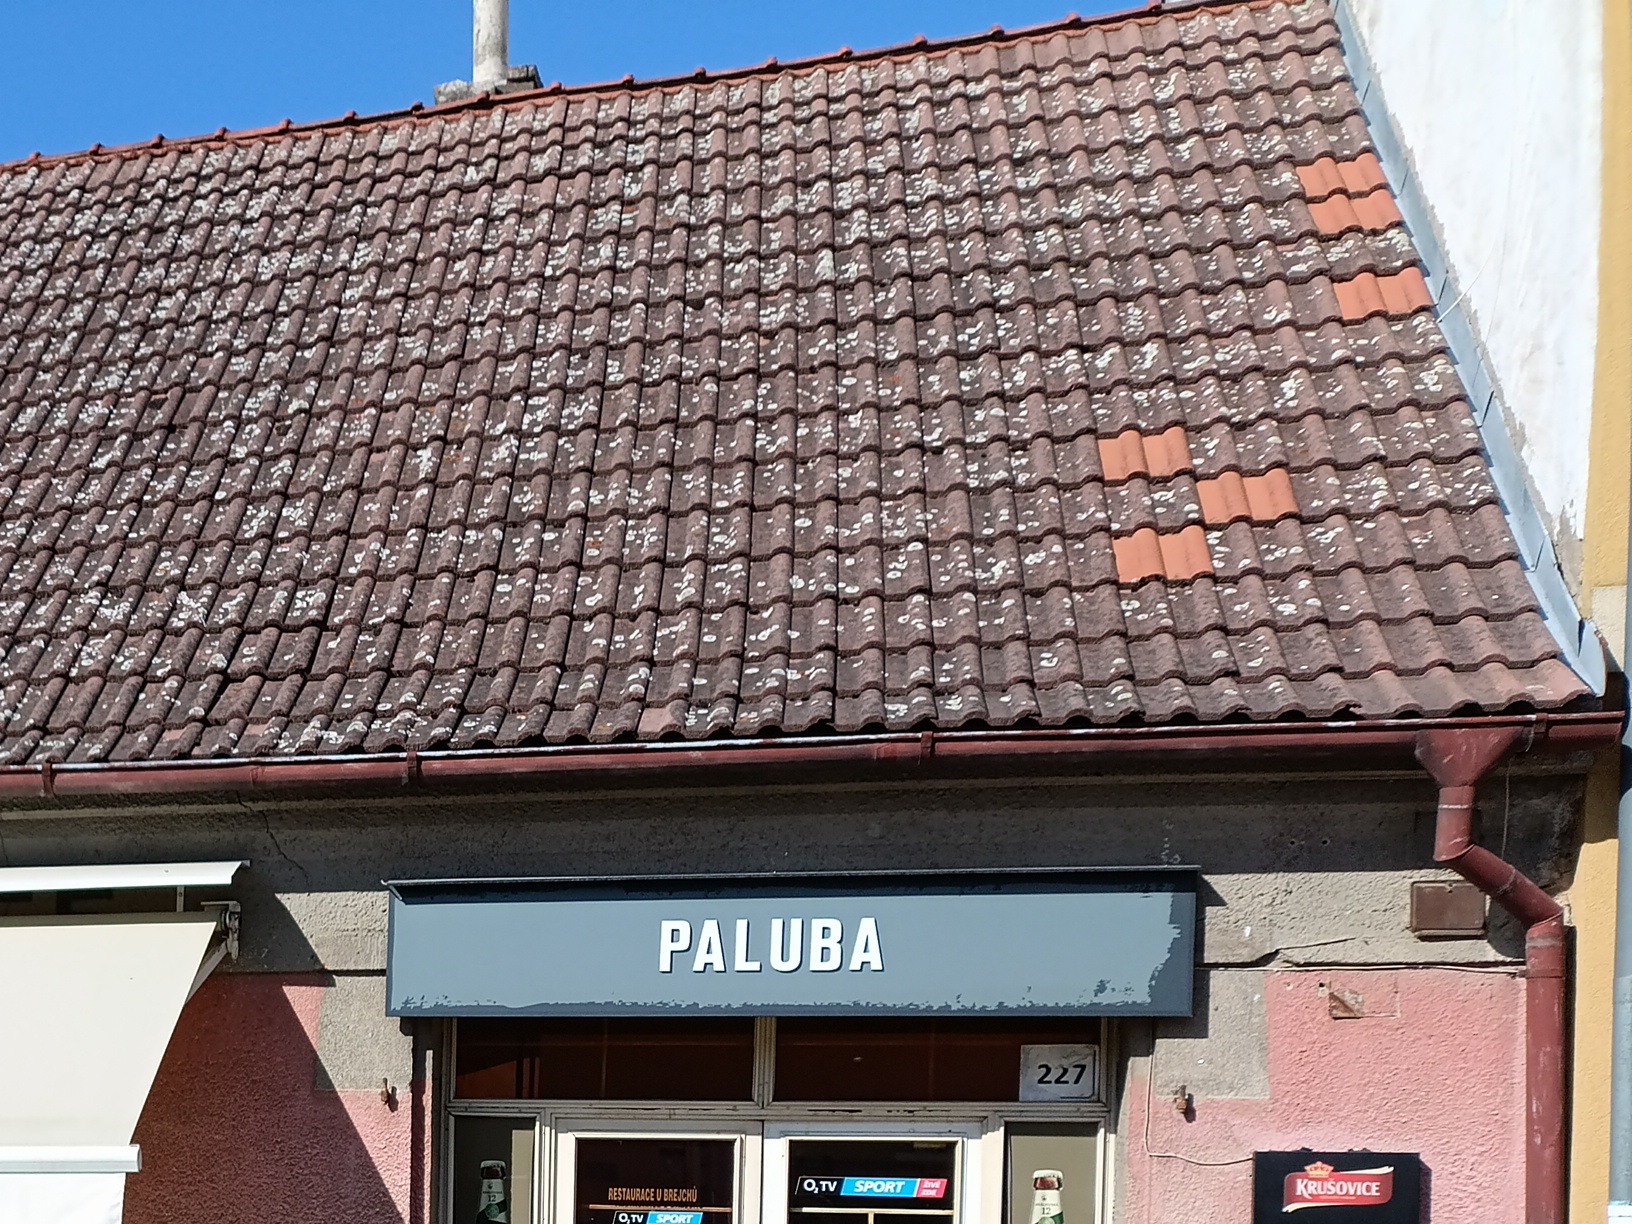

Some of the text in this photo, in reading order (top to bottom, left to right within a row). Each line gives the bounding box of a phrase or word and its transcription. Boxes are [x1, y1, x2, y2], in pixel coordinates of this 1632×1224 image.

[658, 917, 884, 974] PALUBA
[1037, 1063, 1087, 1085] 227
[608, 1185, 698, 1203] RESTAURACE U BREJCHŮ
[820, 1180, 838, 1192] TV
[854, 1180, 906, 1193] SPORT
[1296, 1178, 1381, 1200] KRUŠOVICE
[631, 1214, 644, 1224] TV
[656, 1214, 694, 1224] SPORT
[1041, 1207, 1052, 1215] 12
